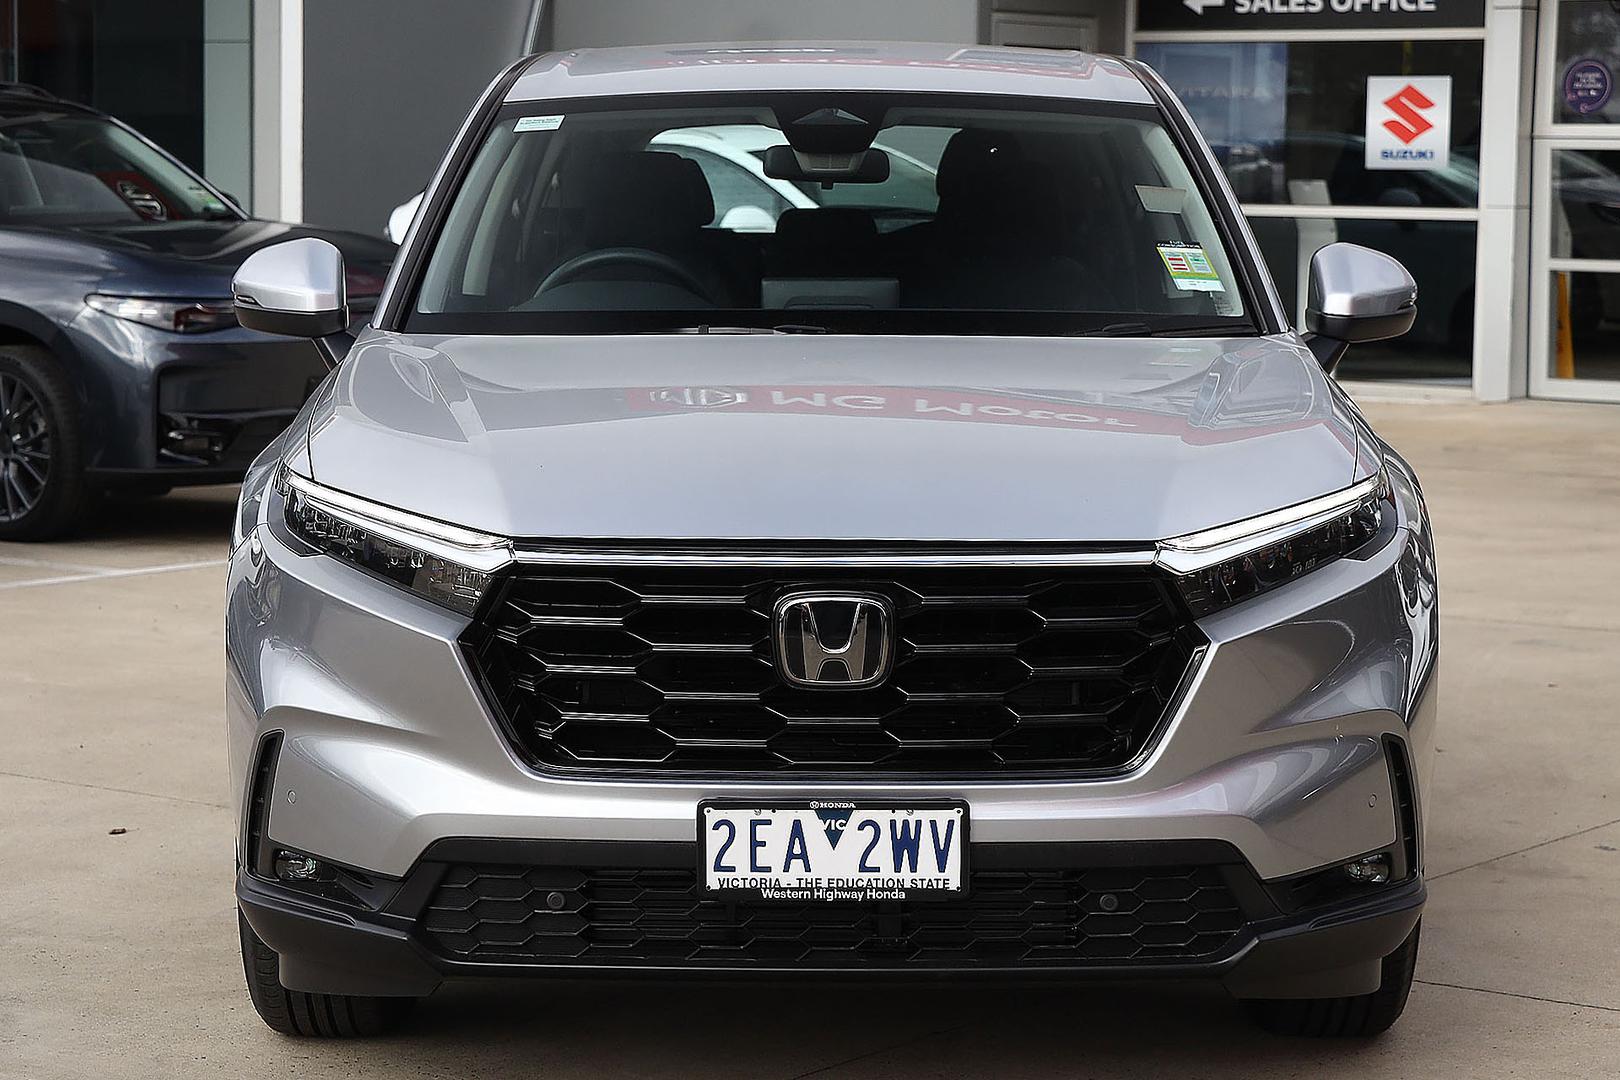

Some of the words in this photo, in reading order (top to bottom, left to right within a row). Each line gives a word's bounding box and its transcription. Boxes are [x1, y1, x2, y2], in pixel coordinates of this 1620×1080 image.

[1234, 0, 1323, 13] SALES
[1330, 0, 1437, 12] OFFICE
[1381, 149, 1434, 159] SUZUKI
[820, 819, 847, 830] VIC
[712, 819, 812, 873] 2EA
[857, 819, 955, 873] 2WV
[717, 877, 782, 888] VICTORIA
[796, 877, 823, 888] THE
[827, 878, 905, 888] EDUCATION
[910, 878, 950, 889] STATE
[761, 888, 811, 899] Western
[813, 888, 864, 901] Highway
[866, 888, 906, 899] Honda
